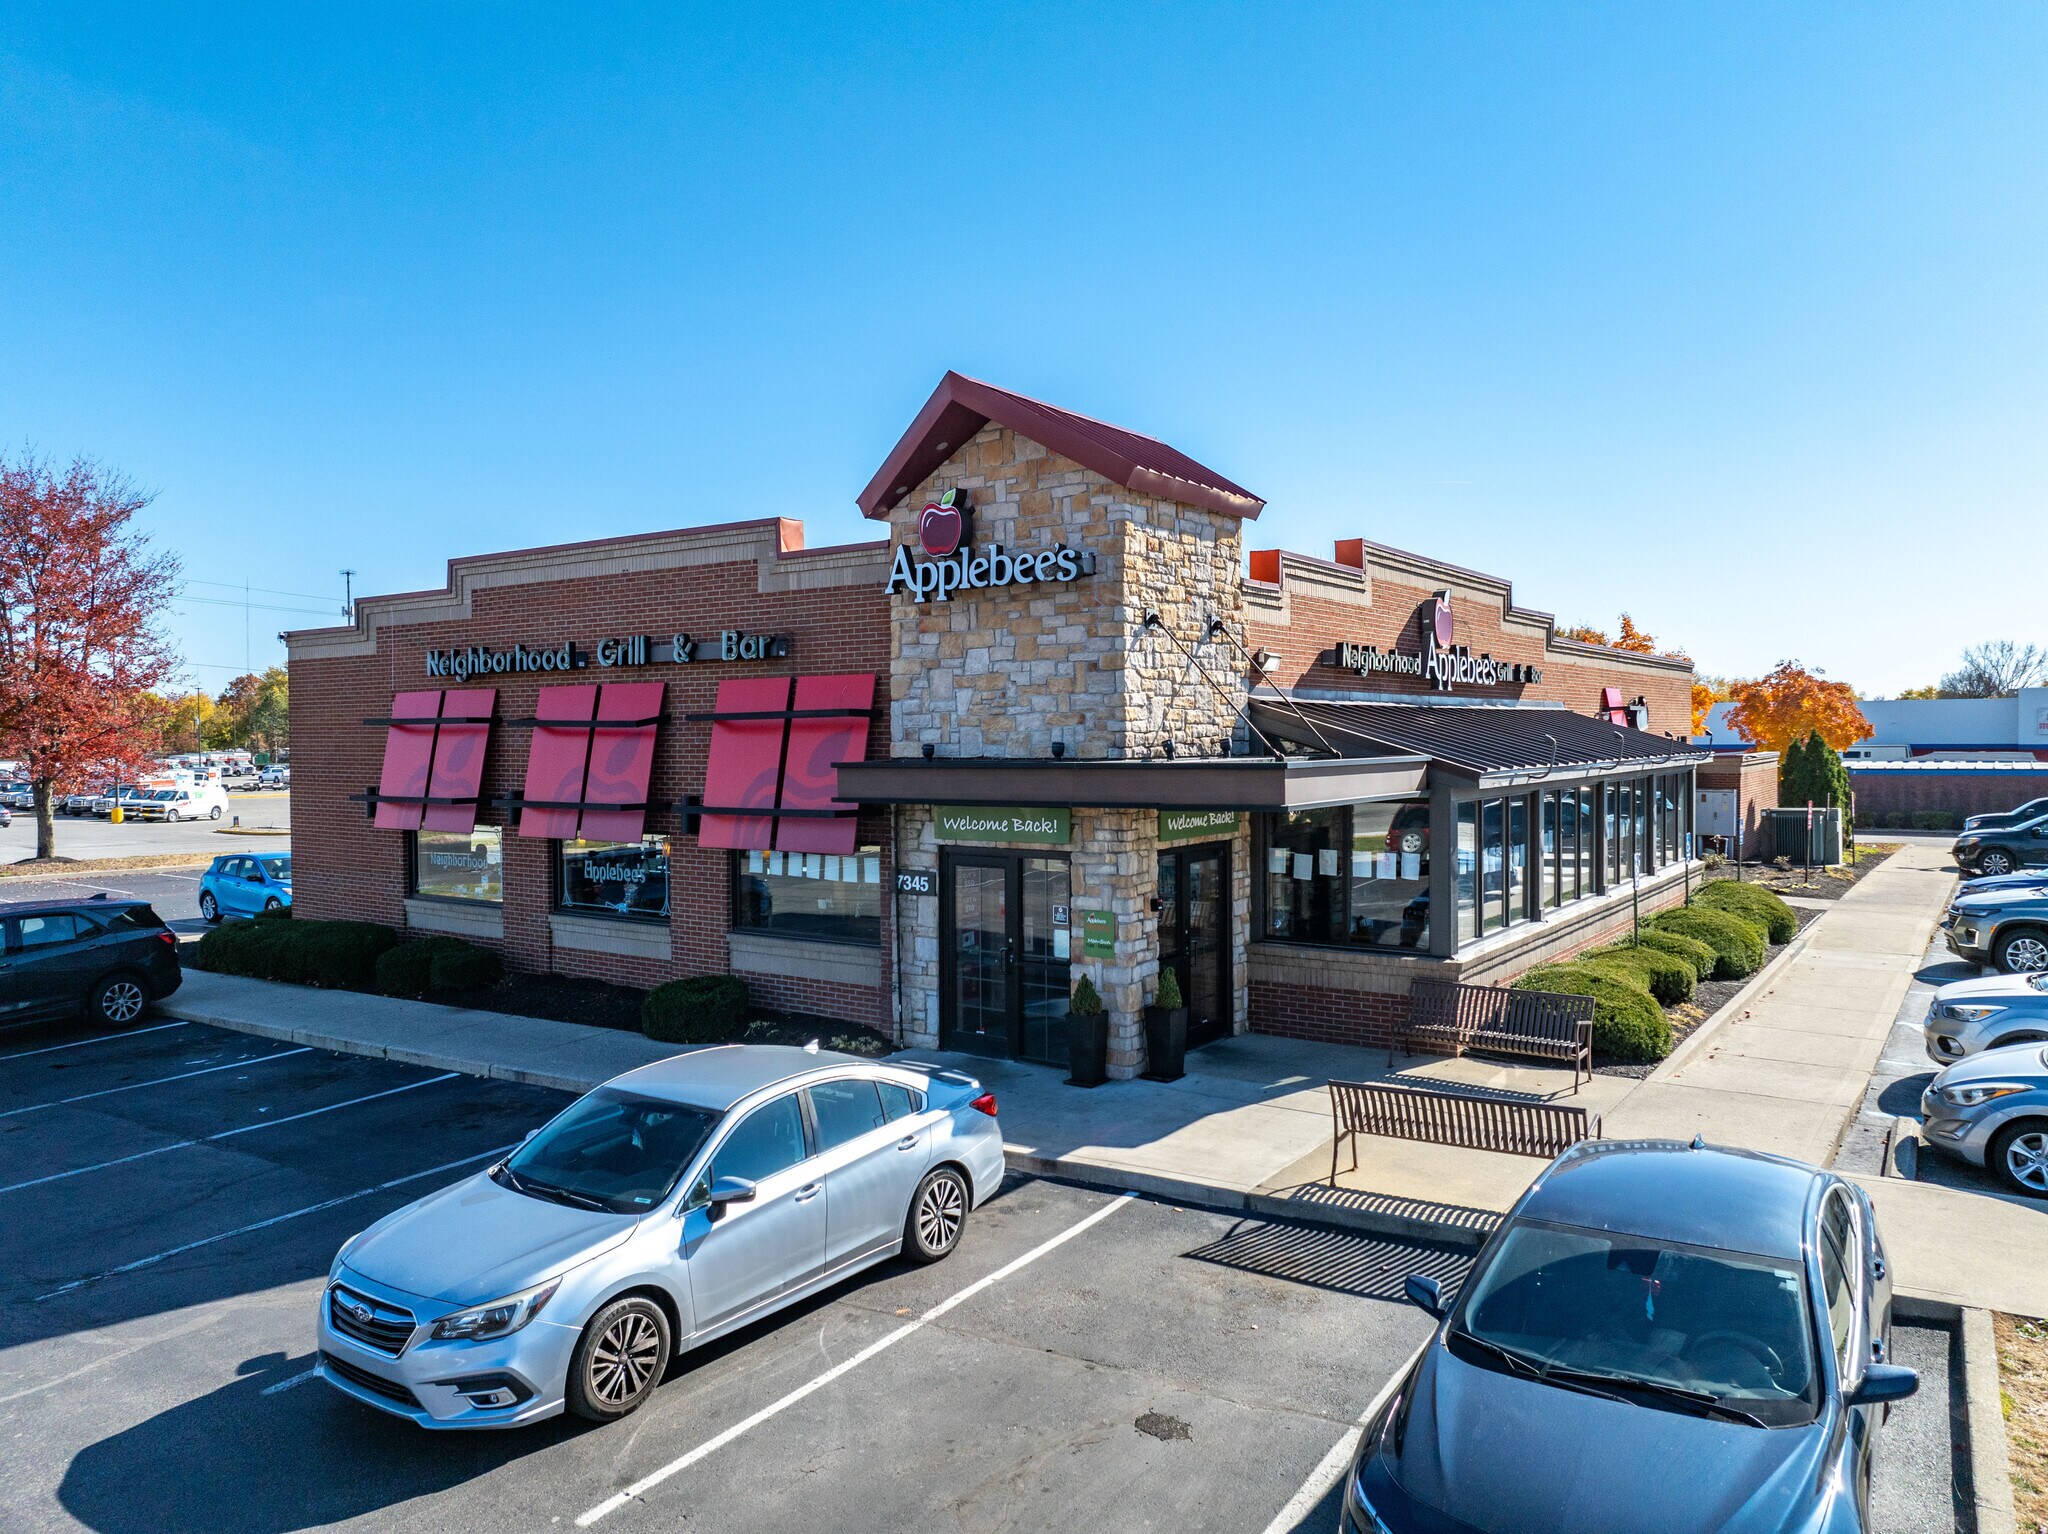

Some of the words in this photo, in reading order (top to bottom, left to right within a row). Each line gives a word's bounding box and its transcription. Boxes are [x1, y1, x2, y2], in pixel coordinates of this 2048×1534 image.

[884, 543, 1078, 603] Applebee's
[426, 641, 573, 683] Neighborhood
[596, 635, 648, 667] Grill
[672, 633, 694, 664] &
[721, 630, 770, 661] Bar
[1342, 642, 1422, 678] Neighborhood
[1425, 632, 1497, 692] Applebee's
[1497, 662, 1513, 682] Grill
[943, 816, 1009, 832] Welcome
[1012, 817, 1058, 834] Back!
[1167, 813, 1208, 831] Welcome
[1209, 811, 1235, 826] Back!
[430, 852, 488, 869] Neighborhood
[584, 860, 646, 884] Applebee's
[897, 874, 929, 892] 7345
